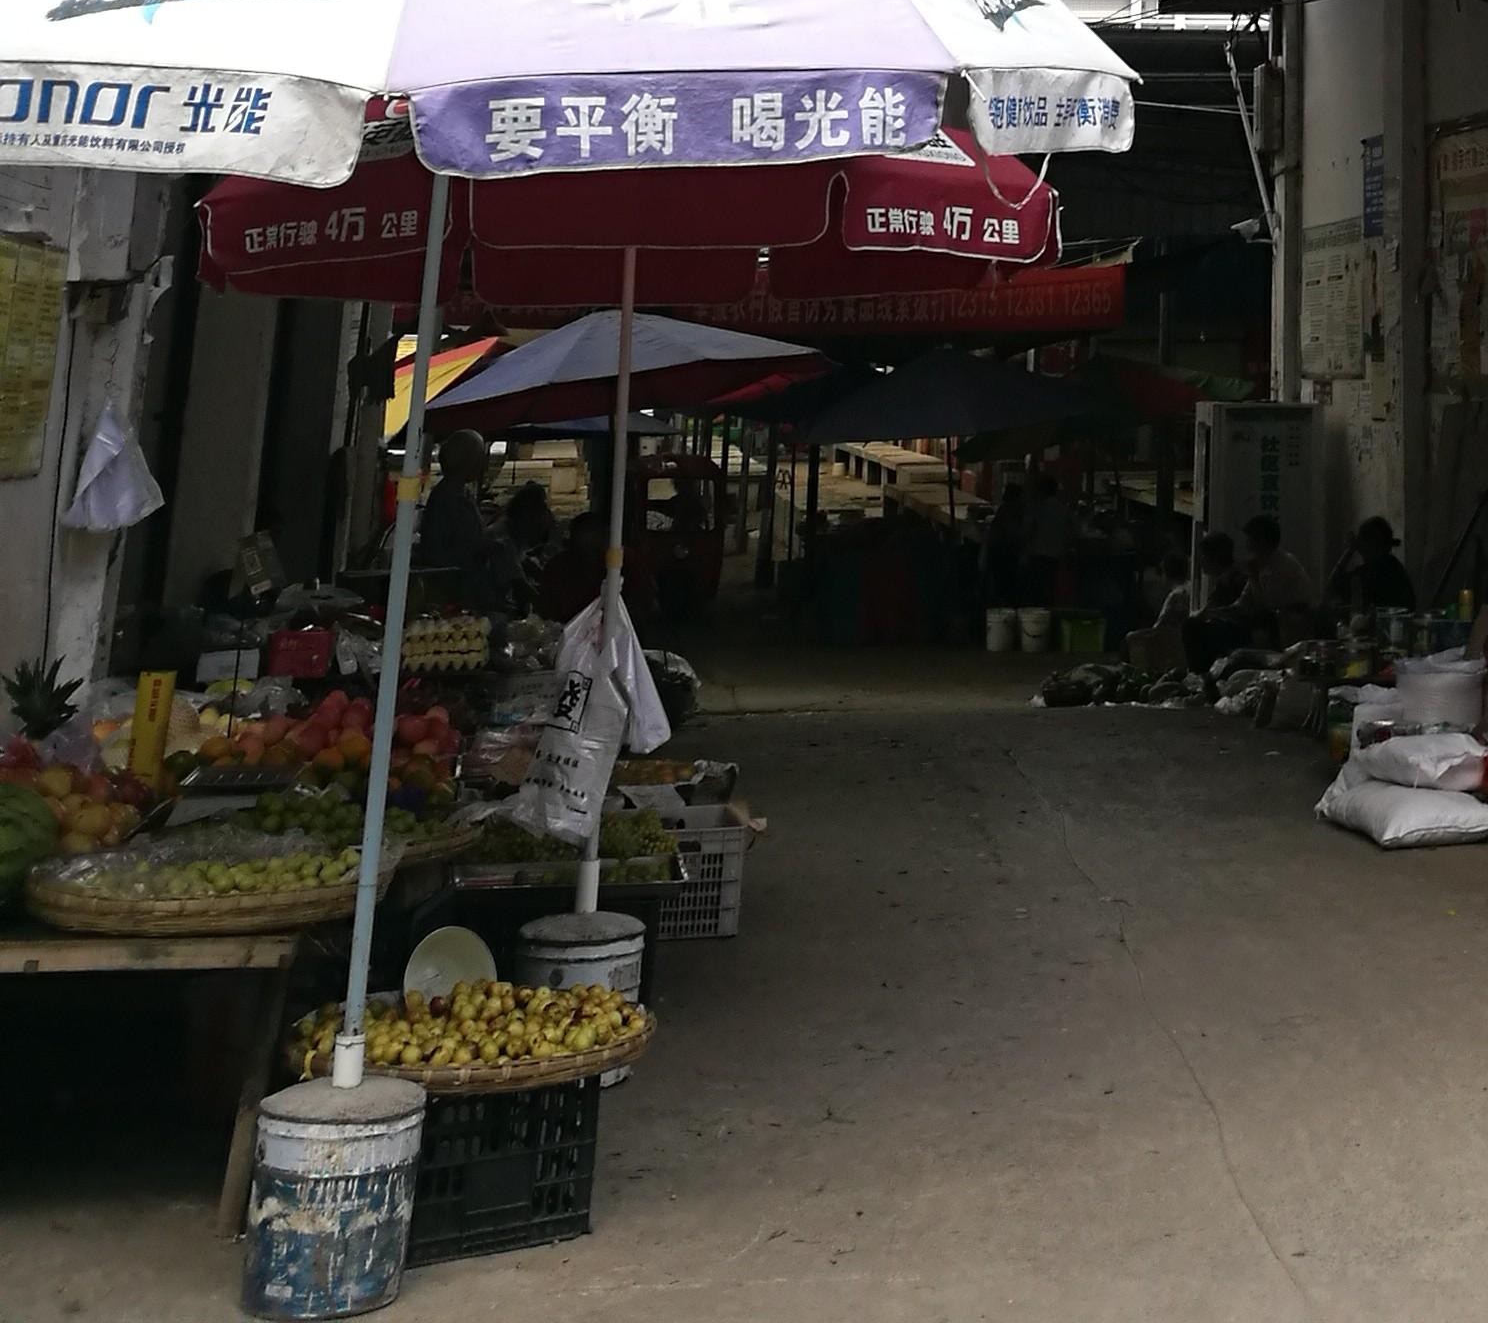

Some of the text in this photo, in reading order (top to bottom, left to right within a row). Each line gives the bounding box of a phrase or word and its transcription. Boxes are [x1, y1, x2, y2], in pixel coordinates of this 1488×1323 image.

[179, 83, 273, 135] 光能
[486, 93, 678, 163] 要平衡
[731, 86, 908, 152] 喝光能
[243, 206, 419, 253] 正常行驶 4万 公里
[866, 205, 1021, 245] 正常行驶 4万 公里
